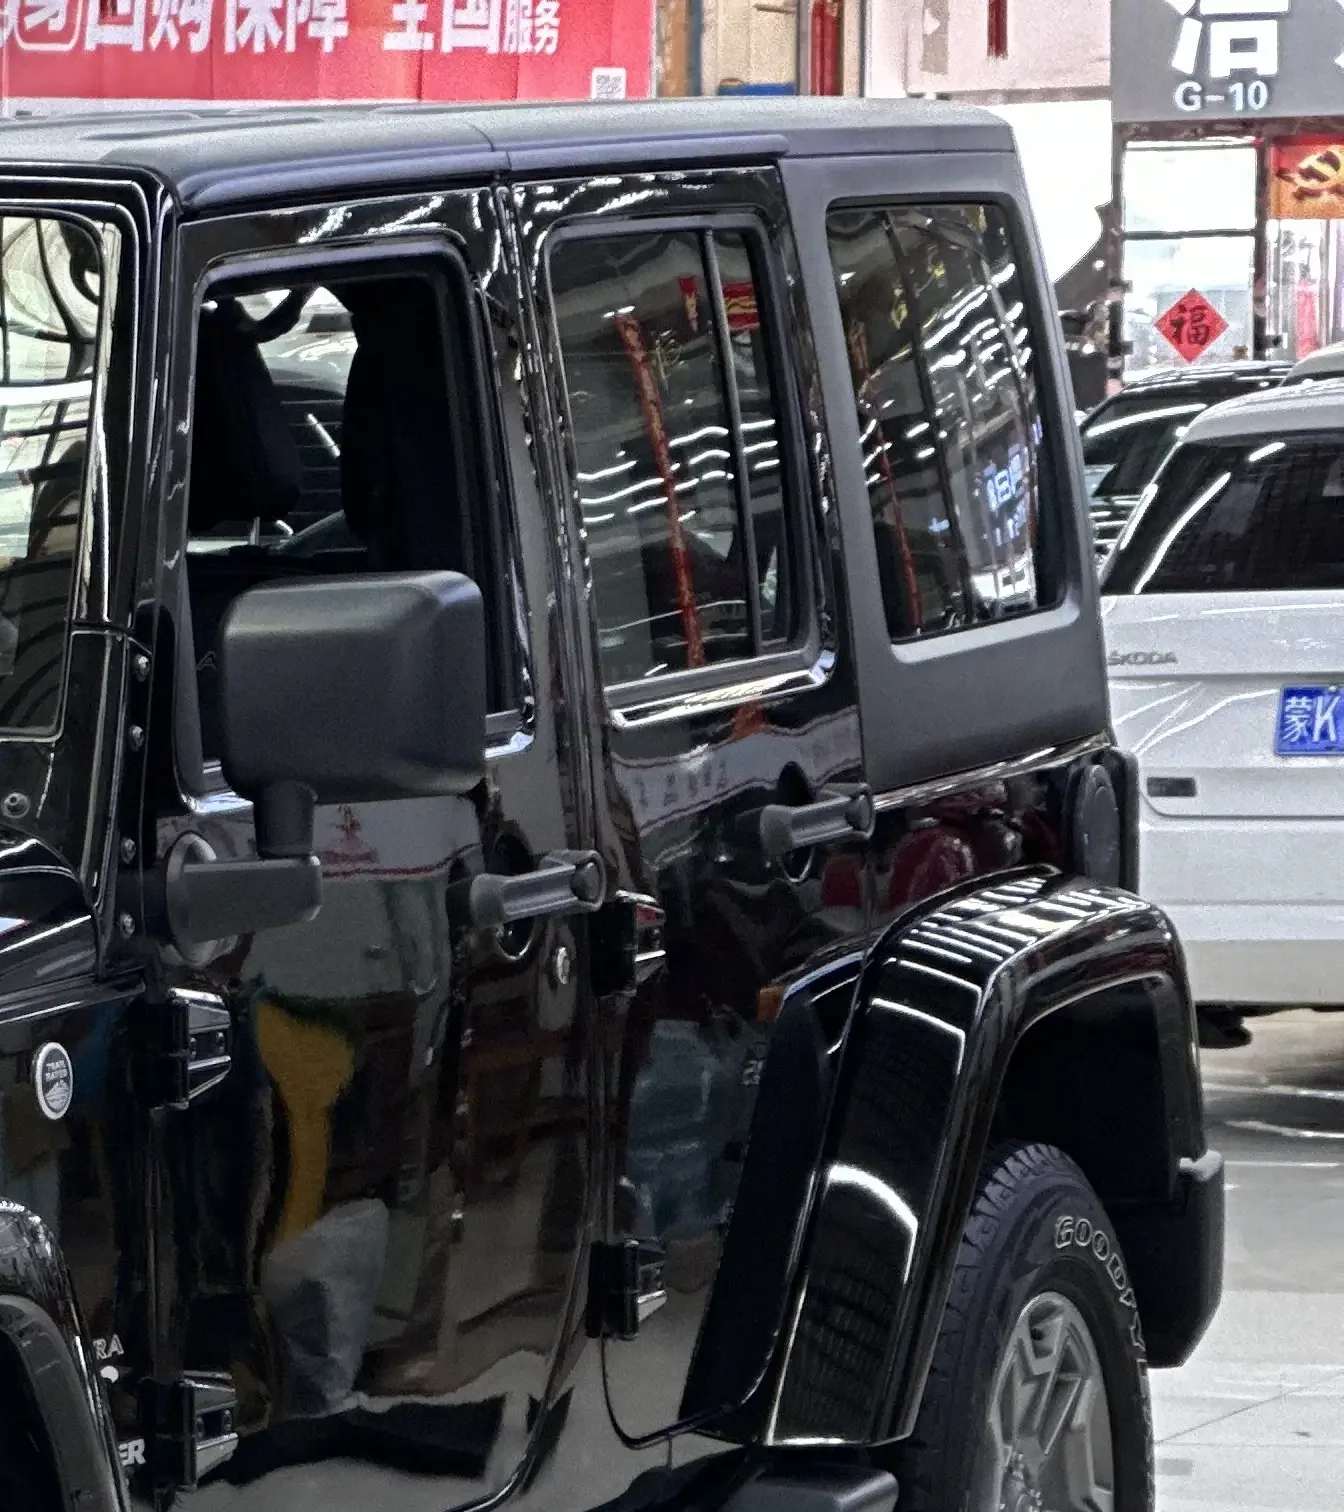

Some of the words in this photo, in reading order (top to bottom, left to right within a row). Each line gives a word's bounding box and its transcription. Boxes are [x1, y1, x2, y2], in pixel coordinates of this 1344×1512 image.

[1174, 80, 1269, 112] G-10
[1169, 303, 1210, 347] 福
[1283, 696, 1340, 743] 蒙K
